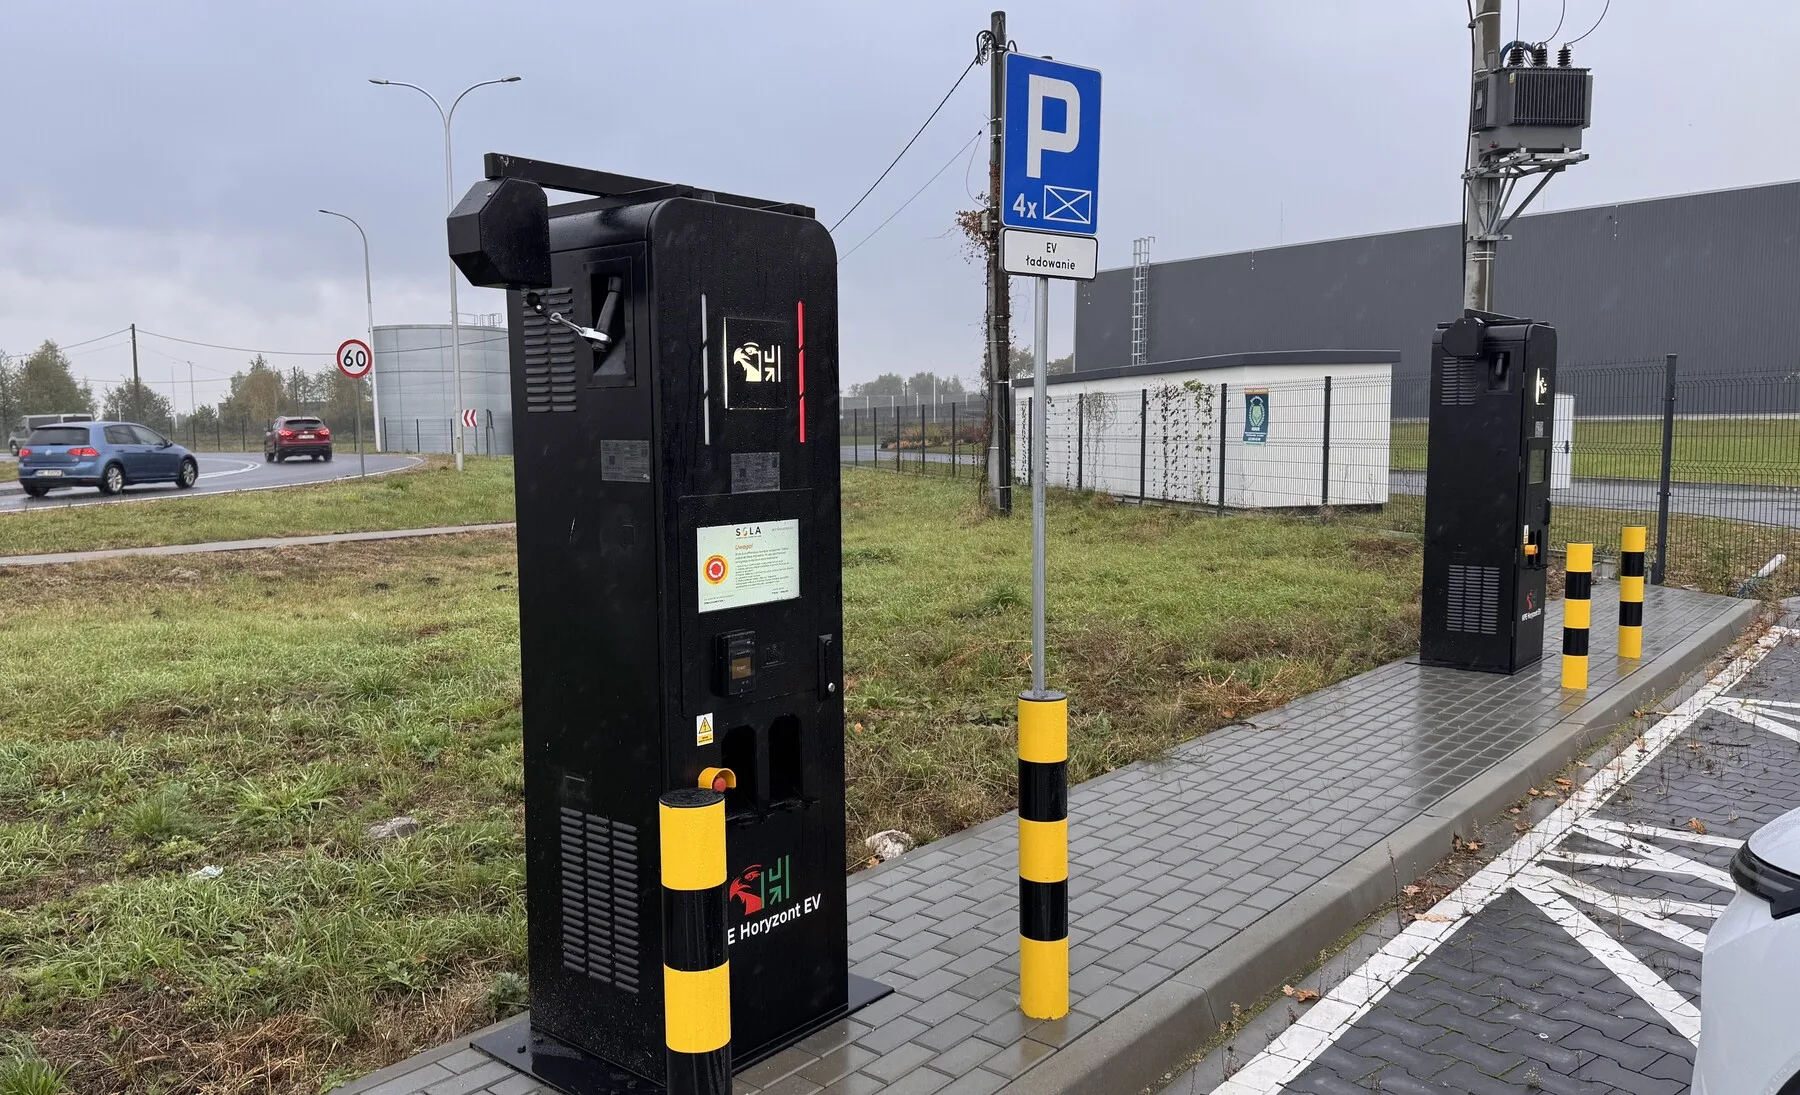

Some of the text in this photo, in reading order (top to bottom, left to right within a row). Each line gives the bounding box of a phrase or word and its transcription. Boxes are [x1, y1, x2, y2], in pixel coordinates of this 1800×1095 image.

[1026, 74, 1081, 178] P
[1012, 193, 1037, 219] 4x
[1046, 242, 1057, 254] EV
[1025, 256, 1076, 271] ładowanie
[343, 349, 366, 367] 60
[735, 526, 761, 537] SOLA
[740, 902, 801, 940] Horyzont
[804, 893, 821, 914] EV
